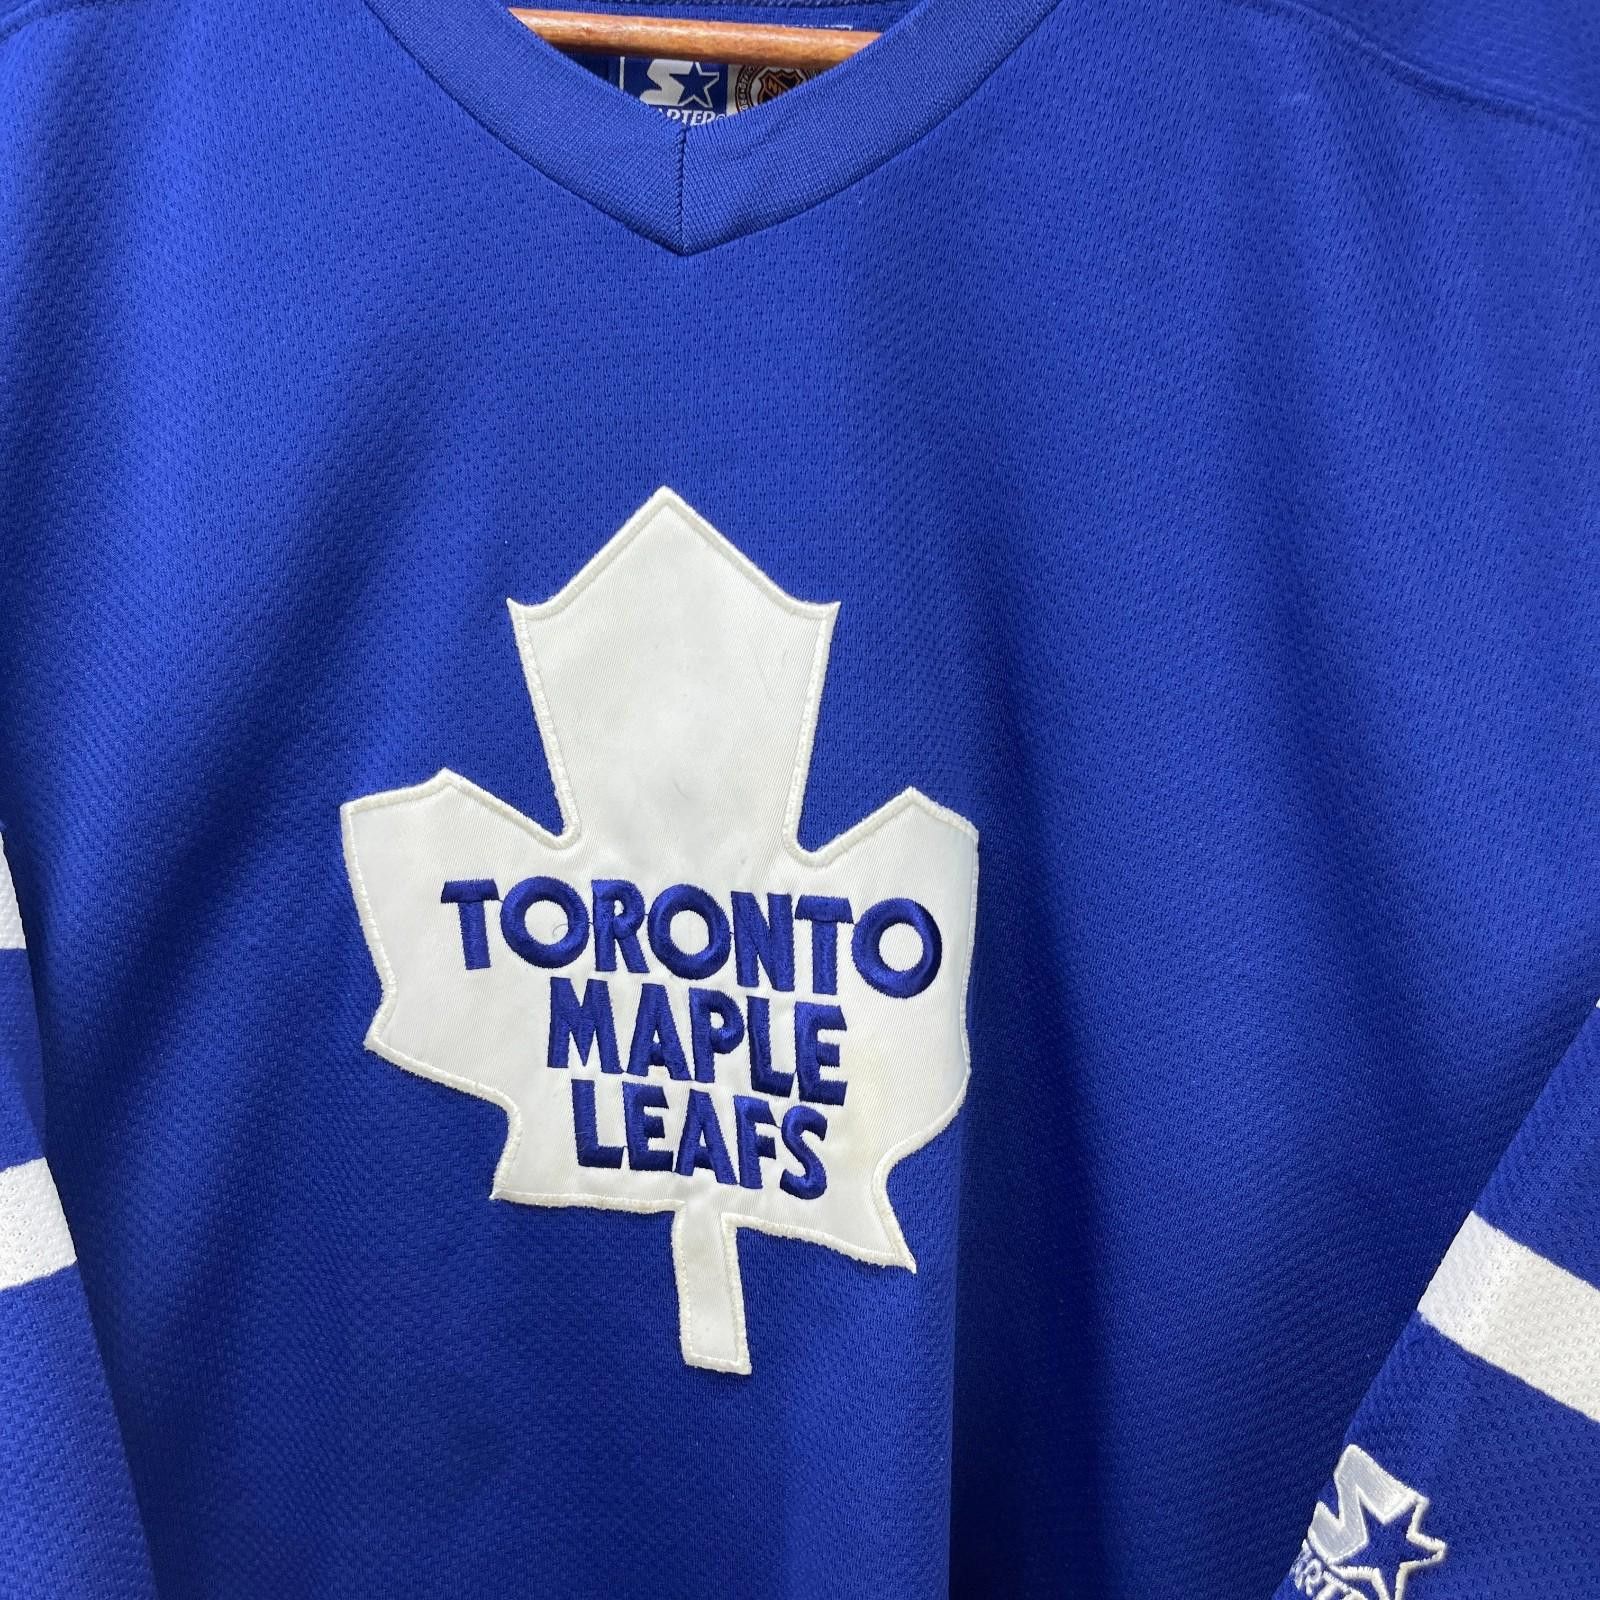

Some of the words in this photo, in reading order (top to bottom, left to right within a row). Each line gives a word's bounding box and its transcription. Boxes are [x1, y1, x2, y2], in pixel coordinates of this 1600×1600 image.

[440, 875, 942, 999] TORONTO
[547, 976, 848, 1106] MAPLE
[571, 1079, 828, 1200] LEAFS
